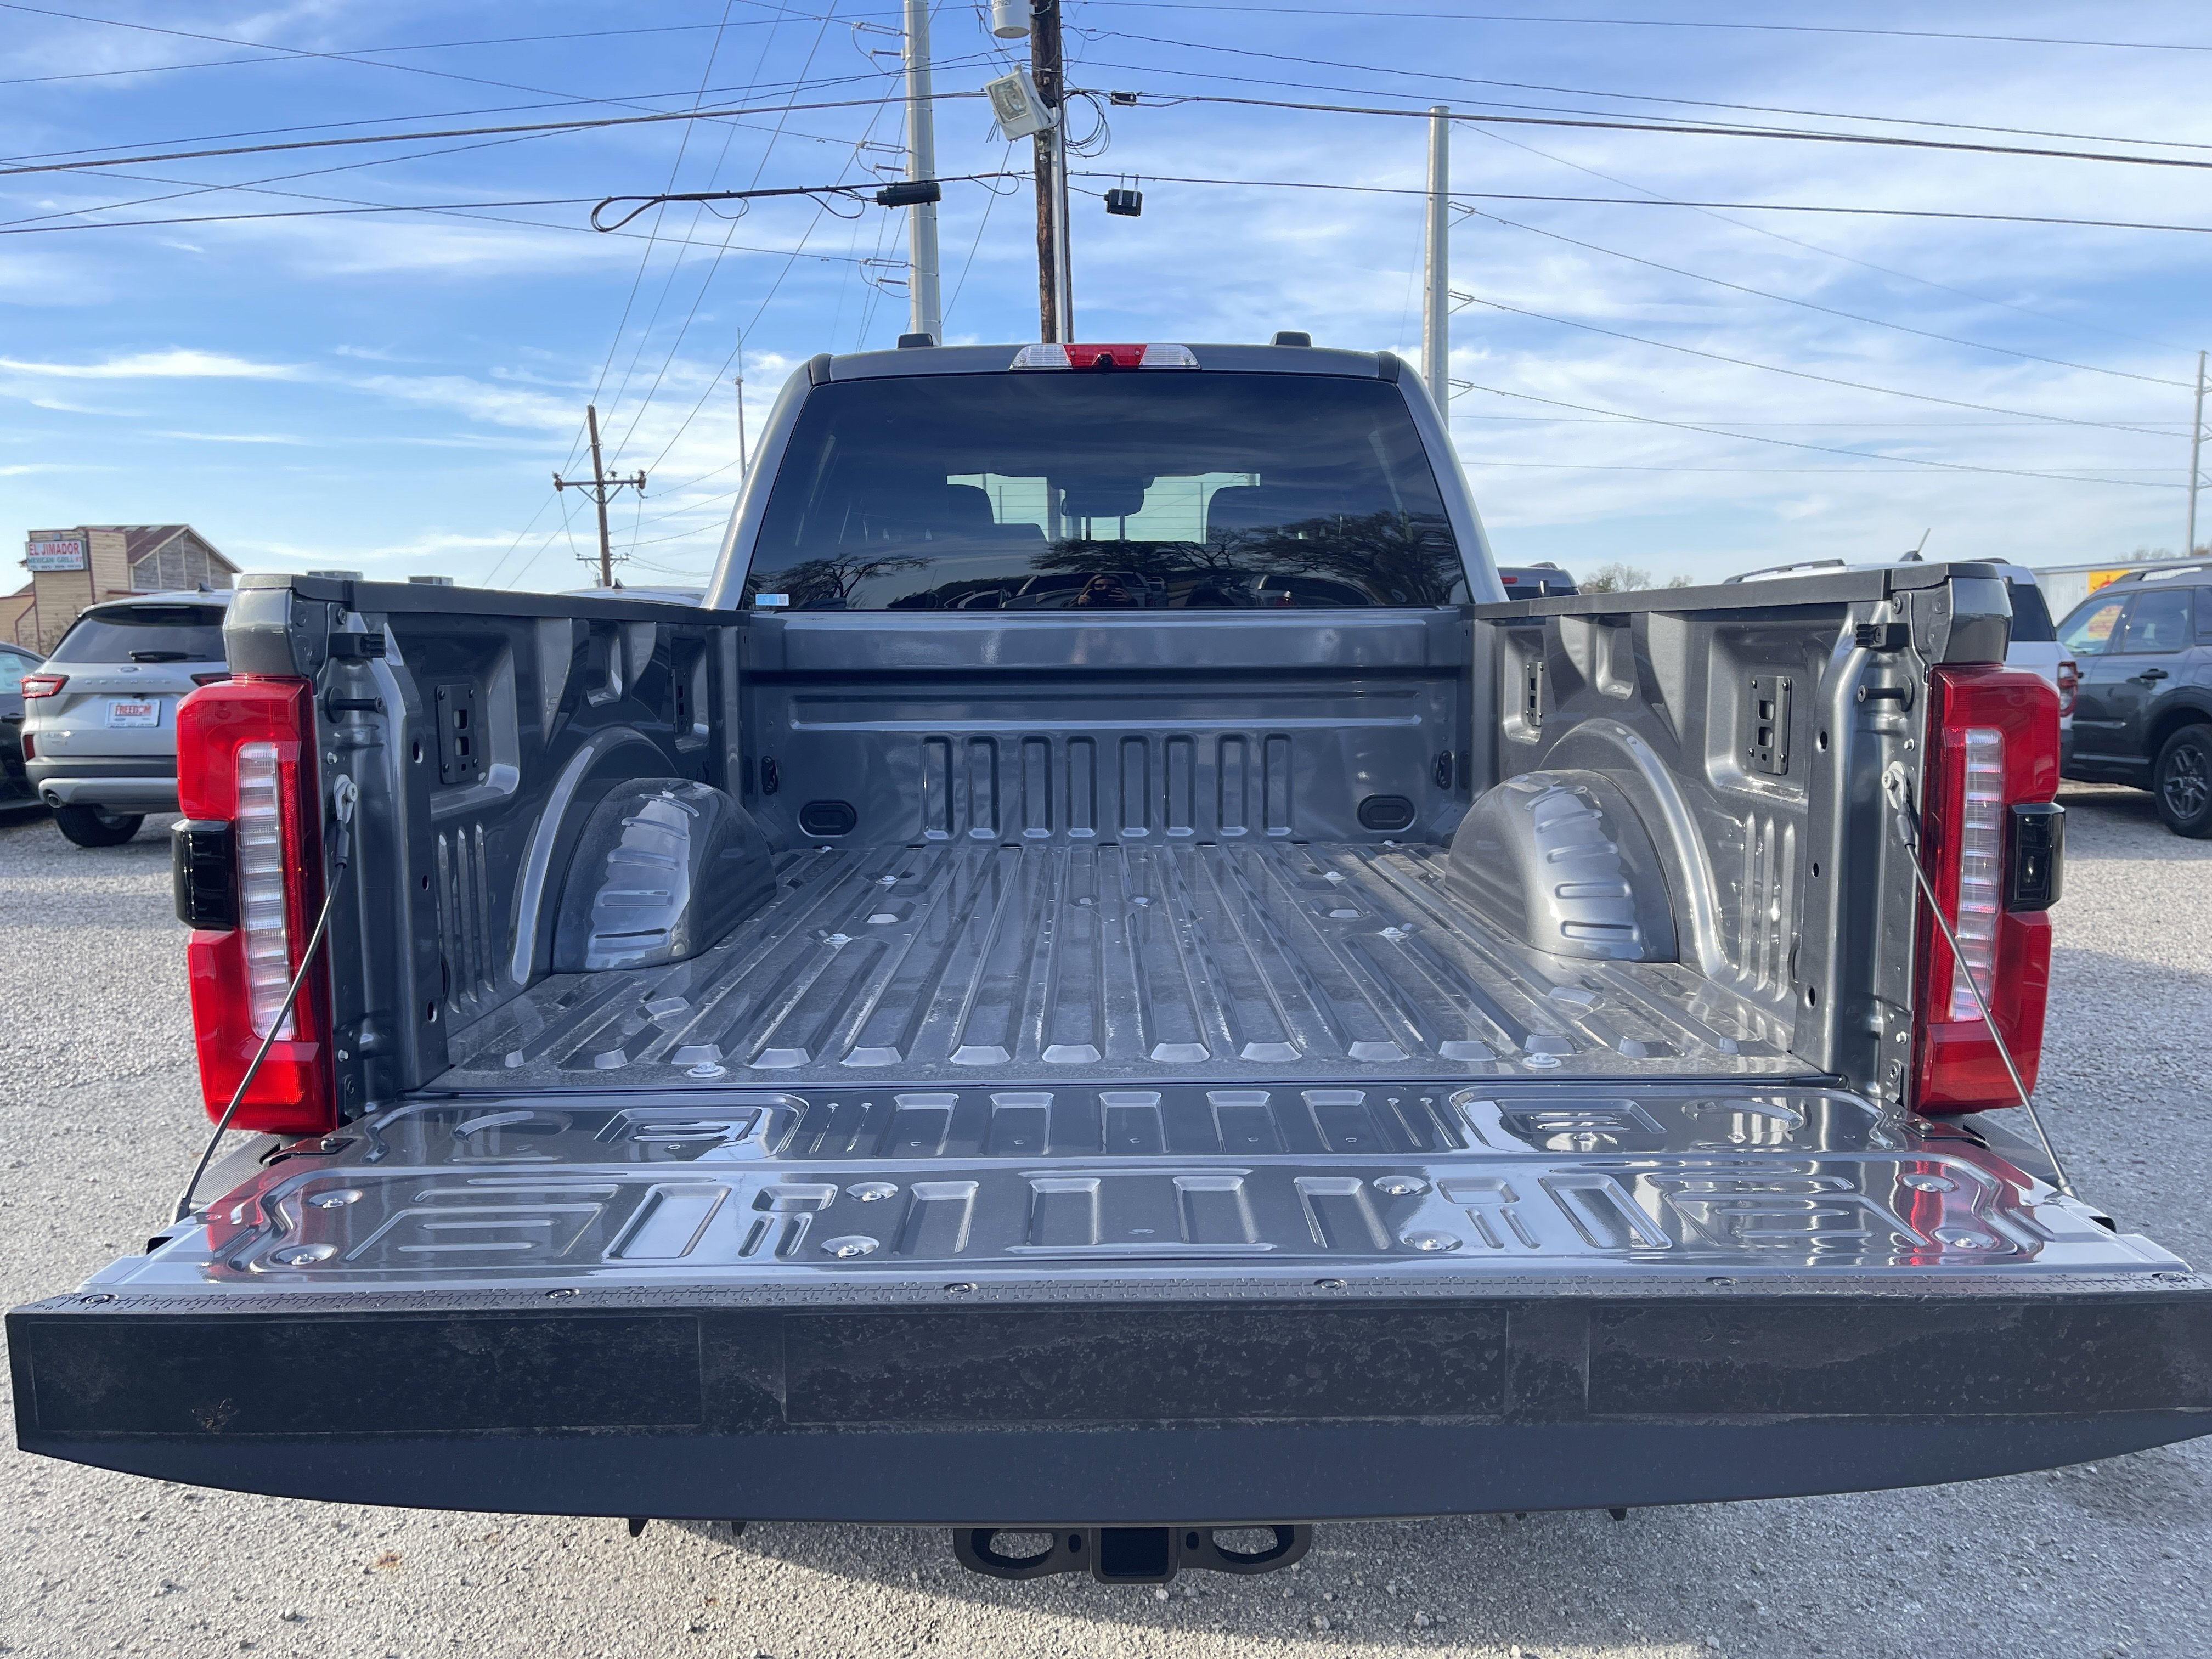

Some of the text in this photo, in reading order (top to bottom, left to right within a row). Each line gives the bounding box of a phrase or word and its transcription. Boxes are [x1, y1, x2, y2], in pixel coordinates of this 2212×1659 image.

[29, 543, 80, 555] EL JIMADOR
[115, 705, 151, 715] FREEDOM
